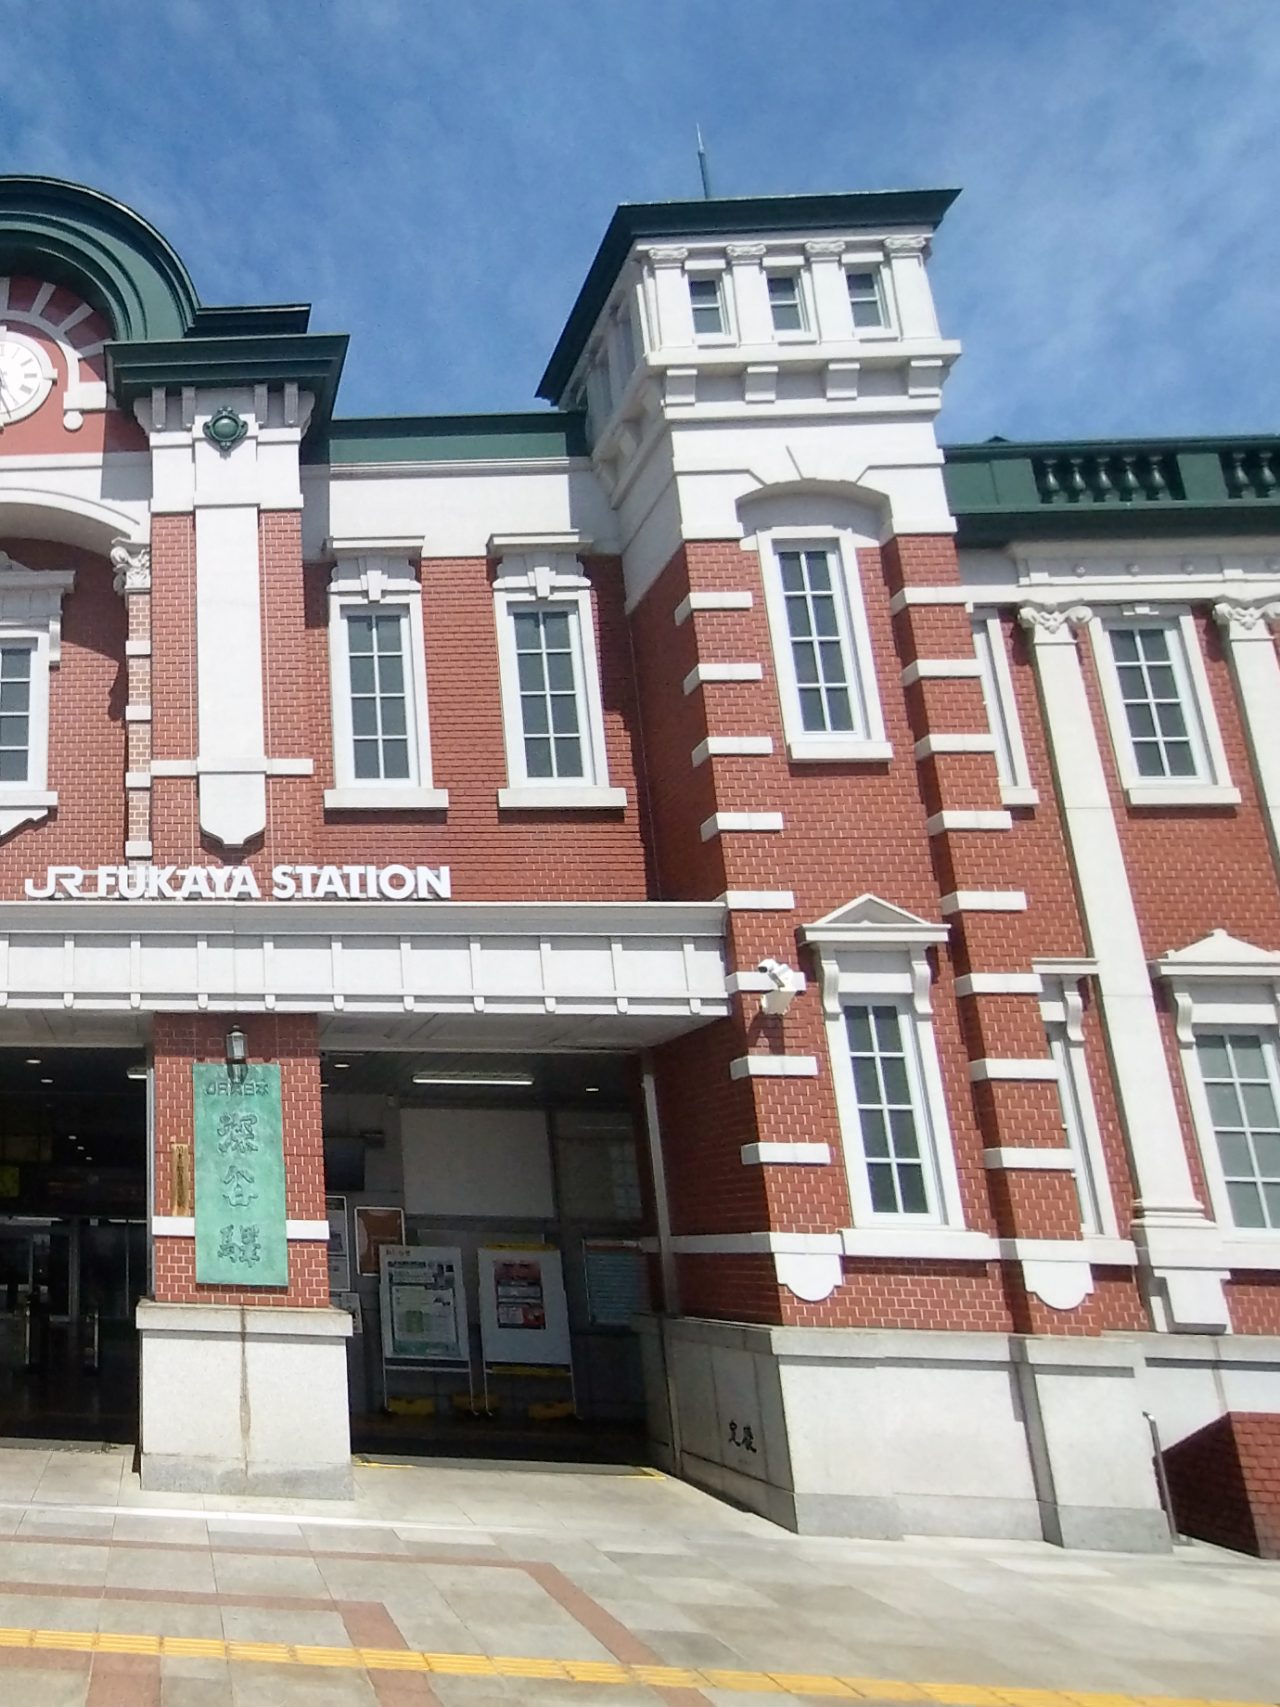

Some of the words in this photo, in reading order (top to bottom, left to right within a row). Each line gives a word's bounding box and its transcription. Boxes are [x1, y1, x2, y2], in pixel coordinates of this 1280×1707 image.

[24, 865, 84, 899] JR
[97, 865, 261, 899] FUKAYA
[271, 864, 452, 900] STATION
